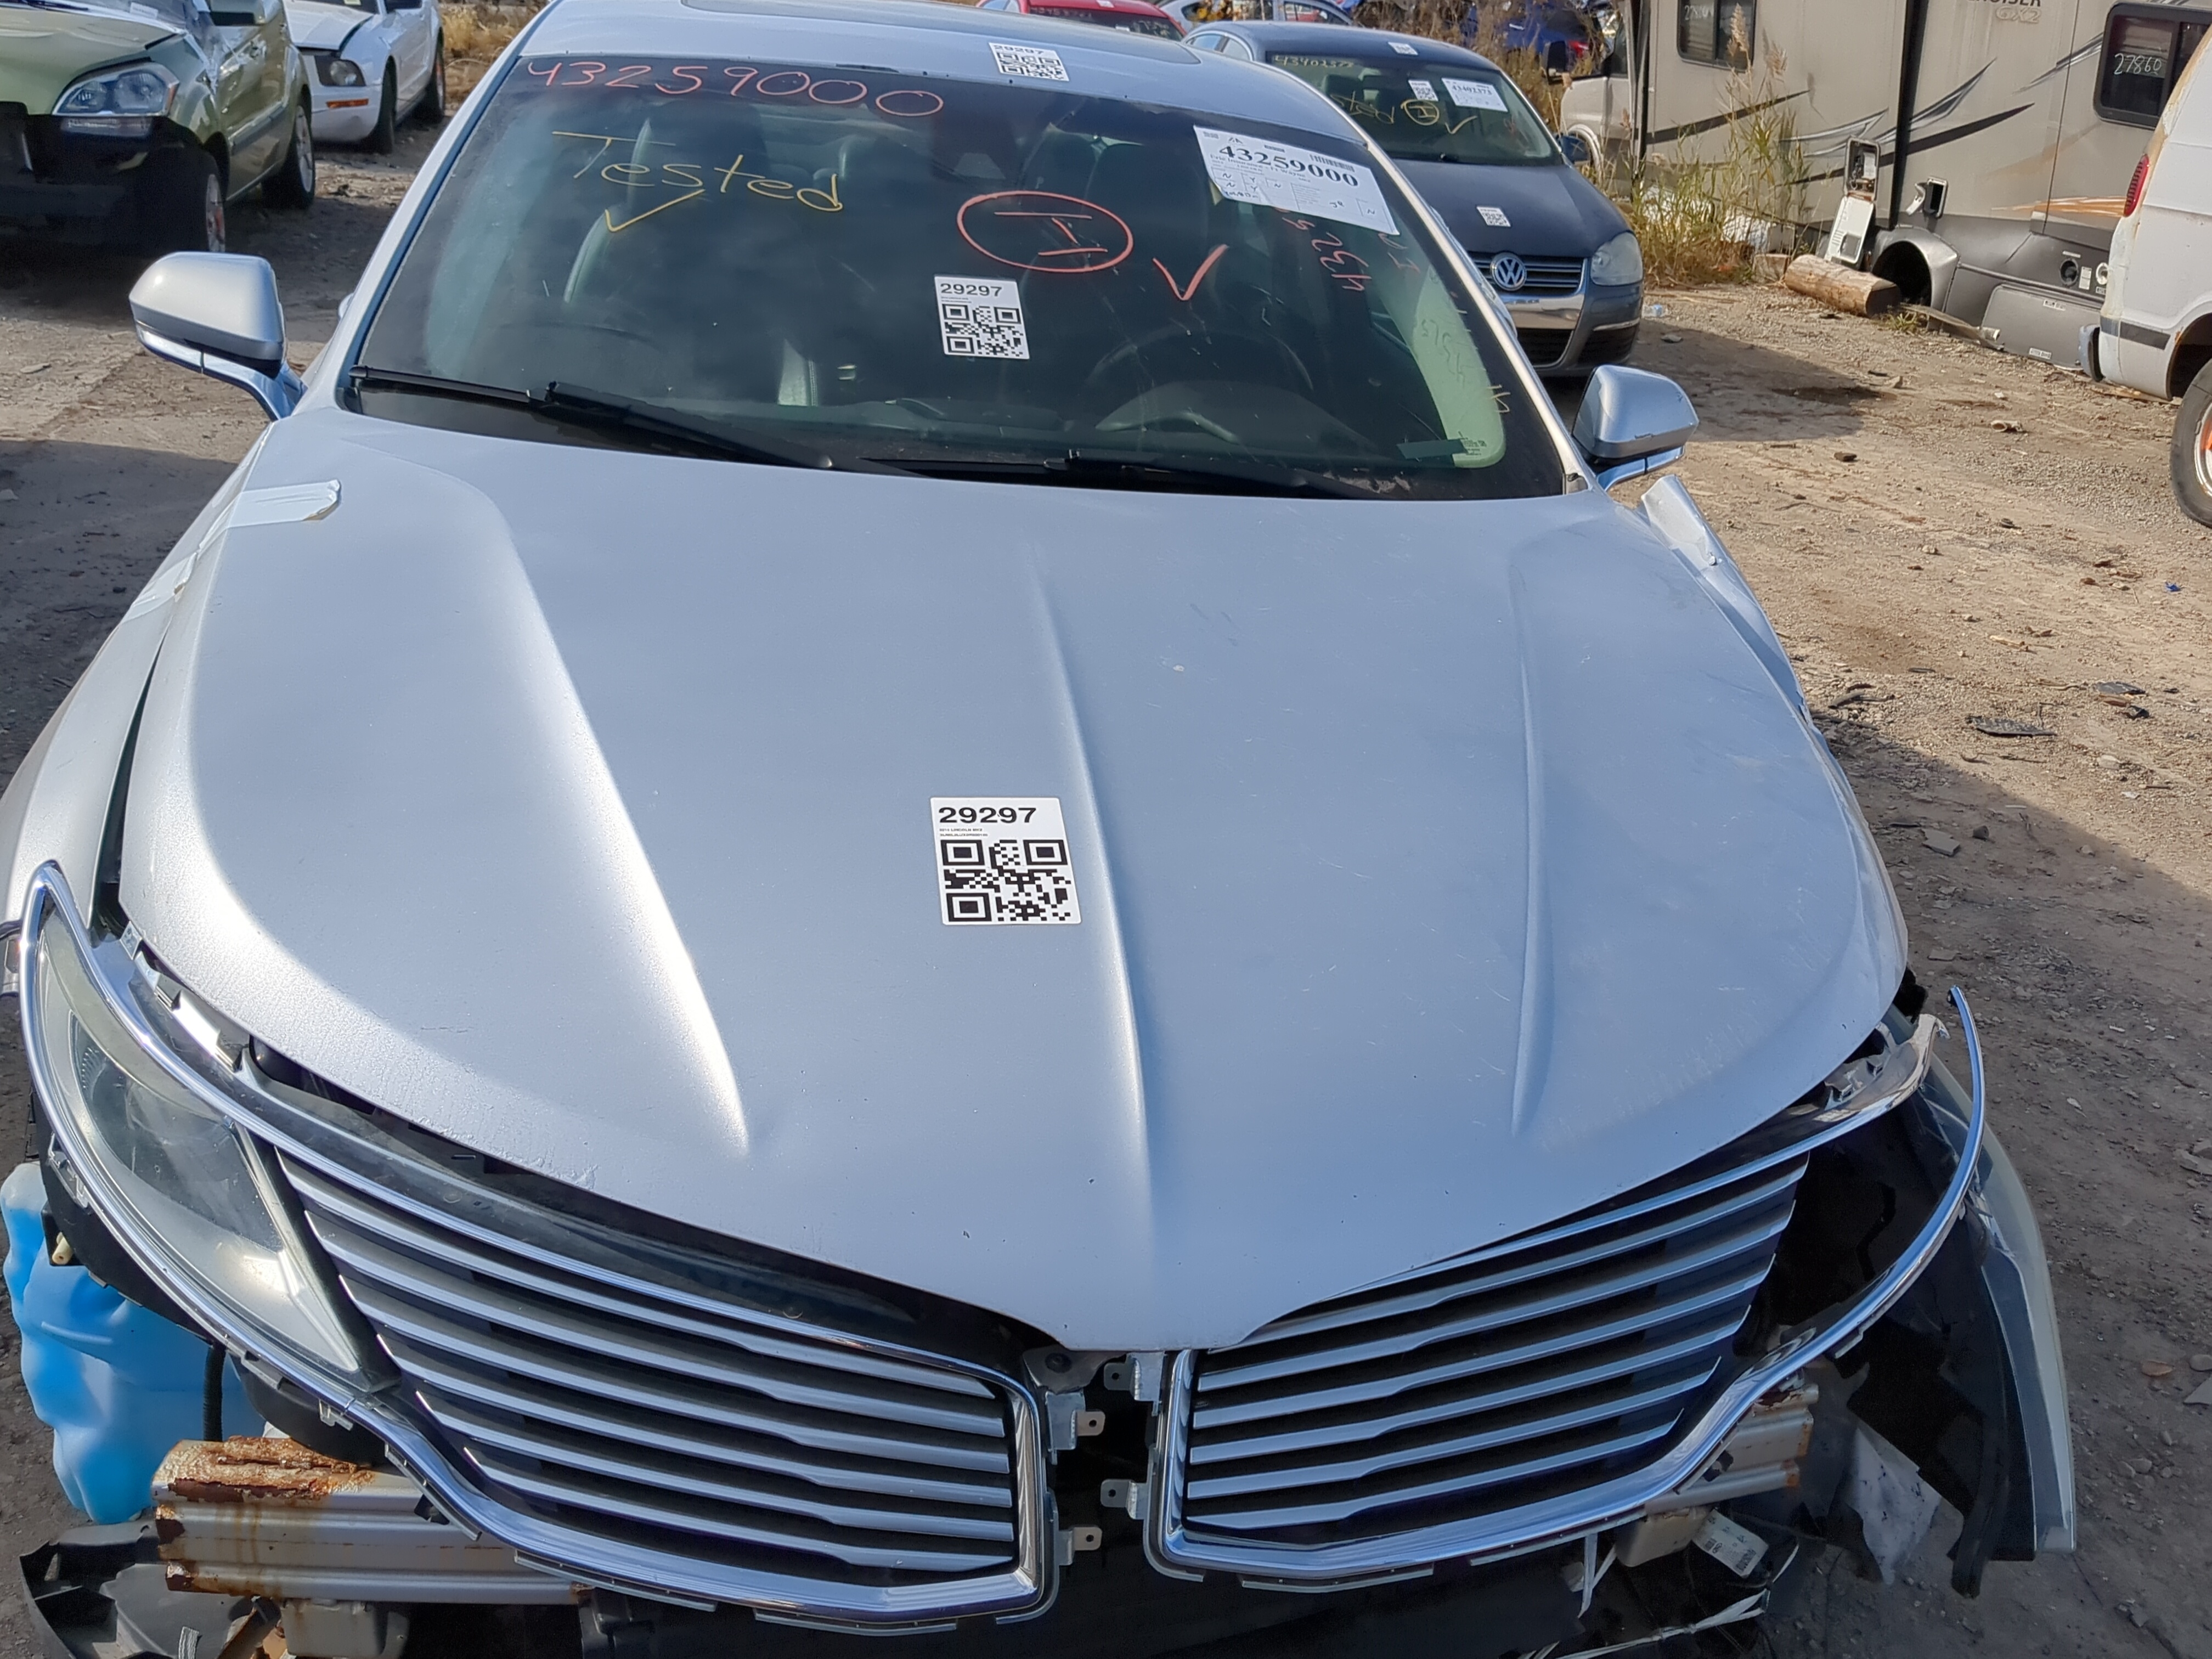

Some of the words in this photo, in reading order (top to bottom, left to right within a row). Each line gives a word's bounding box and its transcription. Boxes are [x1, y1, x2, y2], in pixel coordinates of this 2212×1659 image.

[1996, 5, 2042, 24] GX2
[2113, 53, 2163, 76] 27860
[528, 60, 944, 117] 43259000
[551, 129, 844, 212] Tested
[1218, 145, 1358, 187] 43259000
[1276, 208, 1373, 291] 4325
[940, 283, 1003, 297] 29297
[939, 807, 1036, 823] 29297
